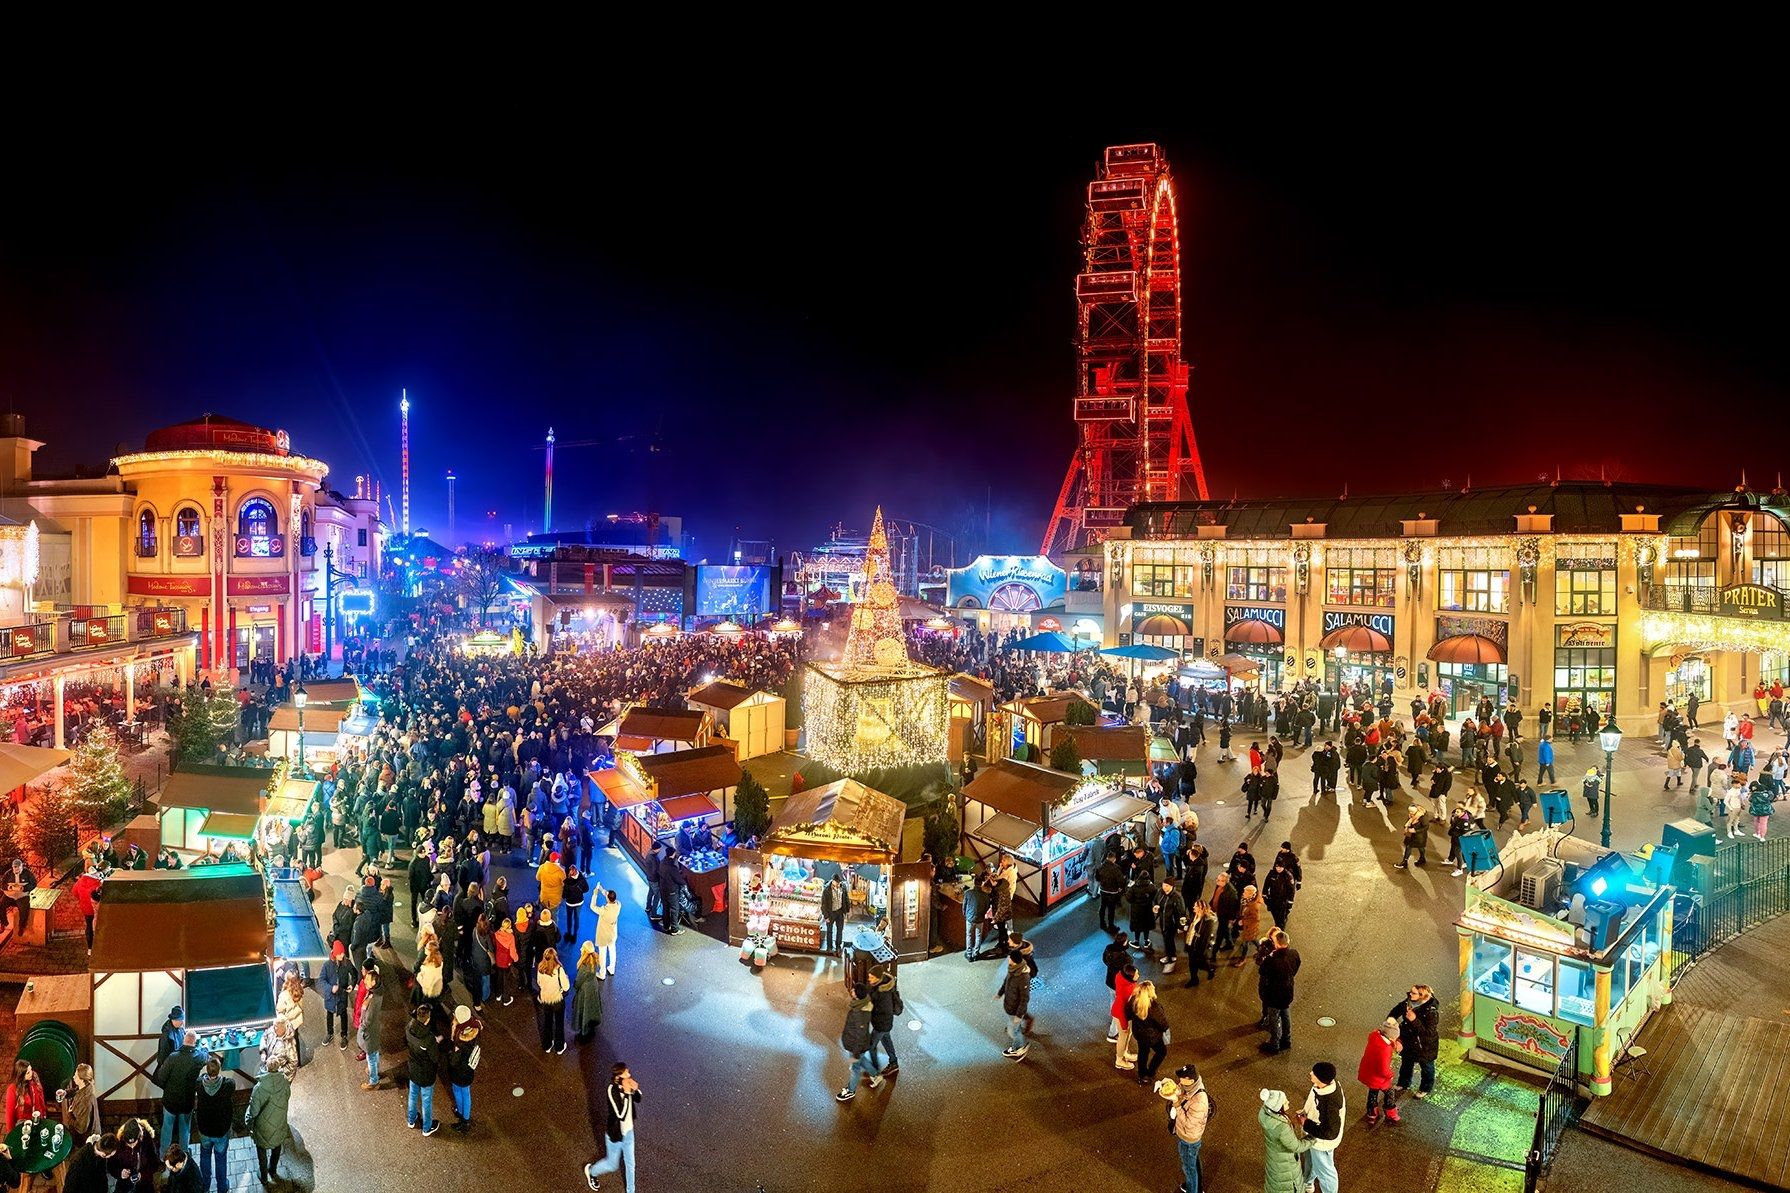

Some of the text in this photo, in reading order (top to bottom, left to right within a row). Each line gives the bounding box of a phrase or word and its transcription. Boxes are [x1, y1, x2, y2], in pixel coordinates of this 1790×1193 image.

[1723, 586, 1776, 608] PRATER
[1143, 603, 1185, 613] EISVOGEL
[1226, 607, 1283, 628] SALAMUCCI
[1324, 612, 1392, 636] SALAMUCCI
[772, 922, 815, 936] Schoko
